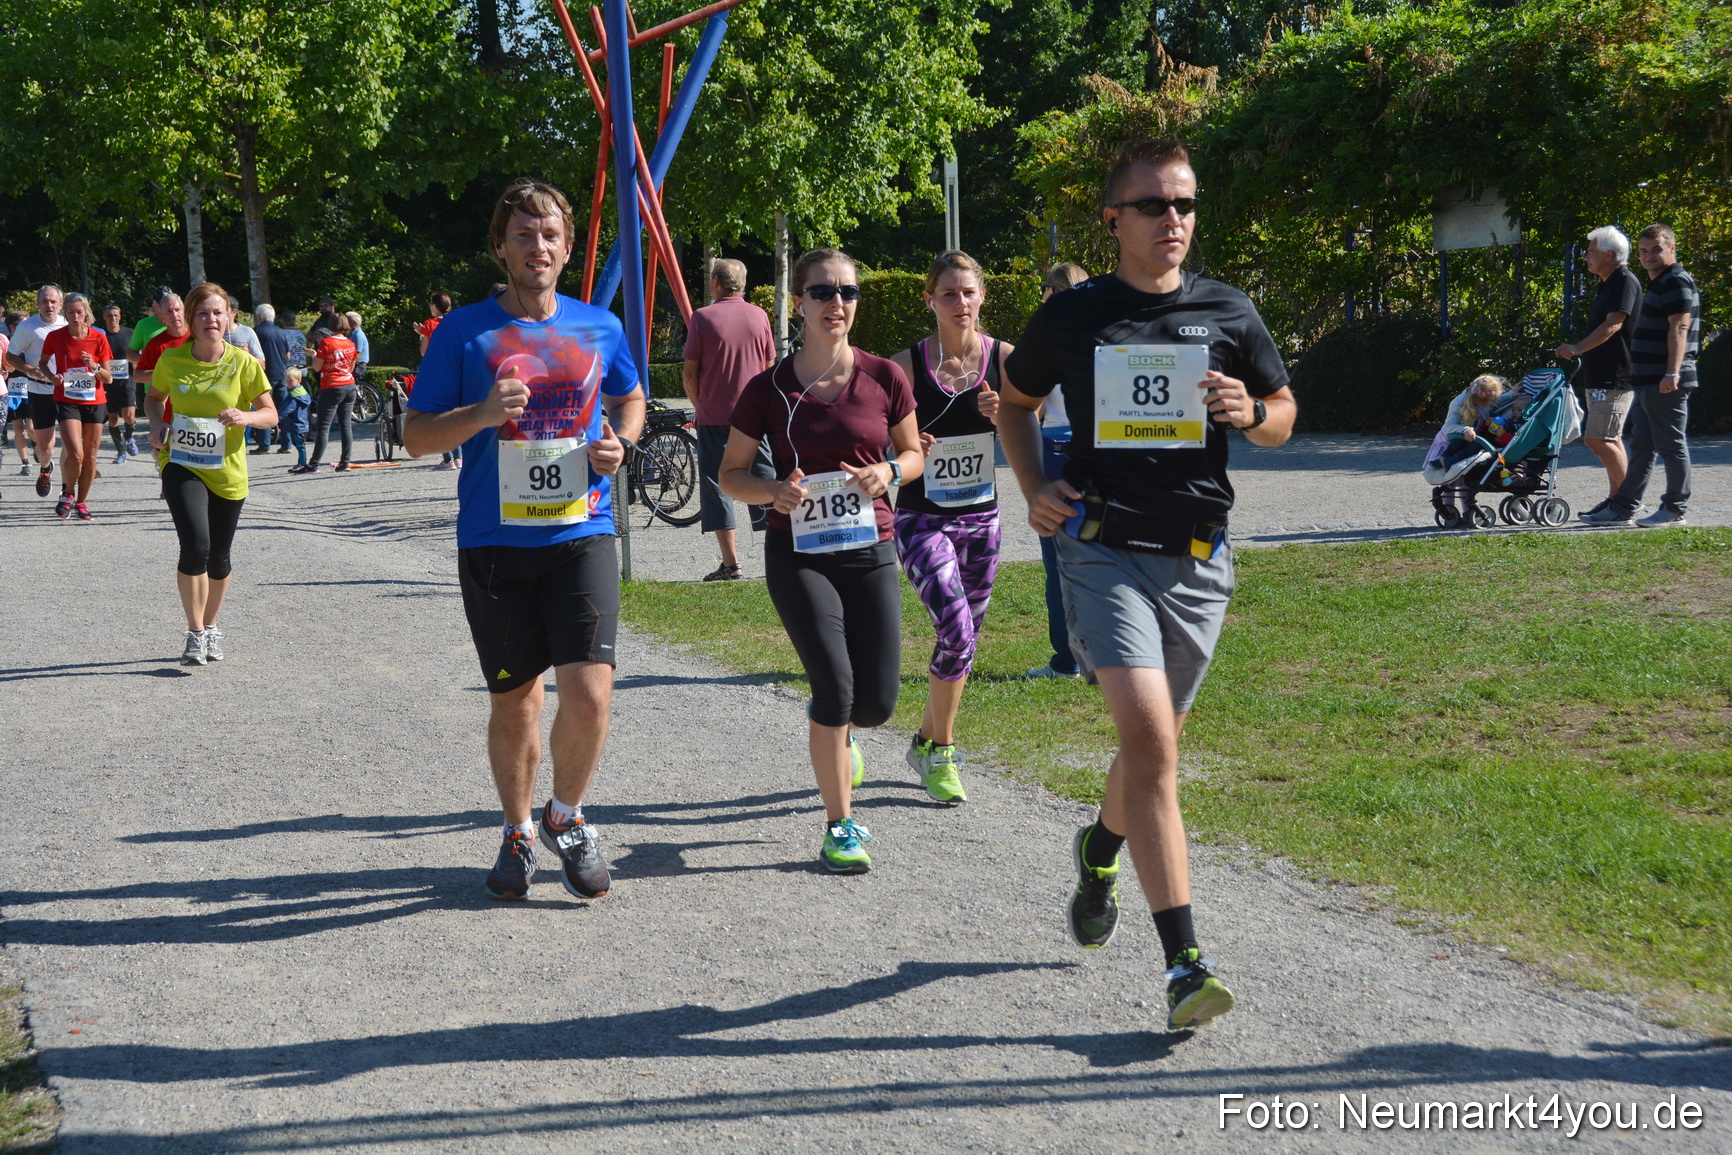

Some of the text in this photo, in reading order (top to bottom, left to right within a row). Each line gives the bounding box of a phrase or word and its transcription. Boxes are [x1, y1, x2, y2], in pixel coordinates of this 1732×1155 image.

[1128, 355, 1176, 366] BOCK
[69, 380, 92, 389] 2435
[1132, 375, 1170, 405] 83
[518, 418, 574, 431] RELAY TEAM
[1125, 424, 1177, 437] Dominik
[177, 429, 217, 448] 2550
[534, 431, 557, 440] 2017
[525, 447, 563, 458] BOCK
[943, 442, 975, 452] BOCK
[933, 453, 983, 480] 2037
[529, 464, 562, 491] 98
[945, 488, 978, 500] Isabella
[526, 505, 566, 517] Manuel
[801, 492, 861, 523] 2183
[809, 520, 852, 530] PARTL Neumarkt
[818, 532, 853, 545] Bianca
